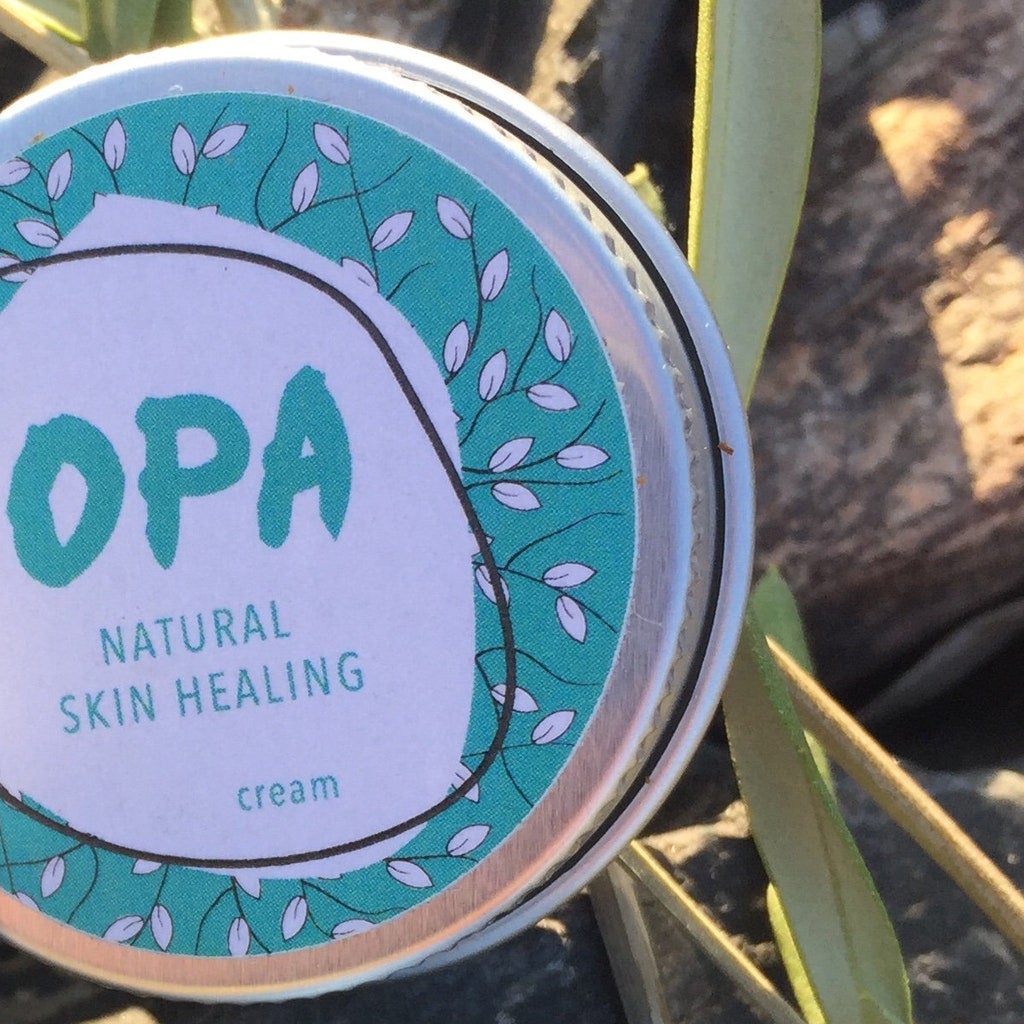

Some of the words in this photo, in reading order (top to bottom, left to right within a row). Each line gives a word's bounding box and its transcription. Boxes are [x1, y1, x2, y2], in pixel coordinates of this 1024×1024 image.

[5, 363, 354, 589] OPA
[99, 599, 292, 666] NATURAL
[59, 682, 157, 735] SKIN
[174, 650, 365, 718] HEALING
[236, 774, 340, 812] cream
